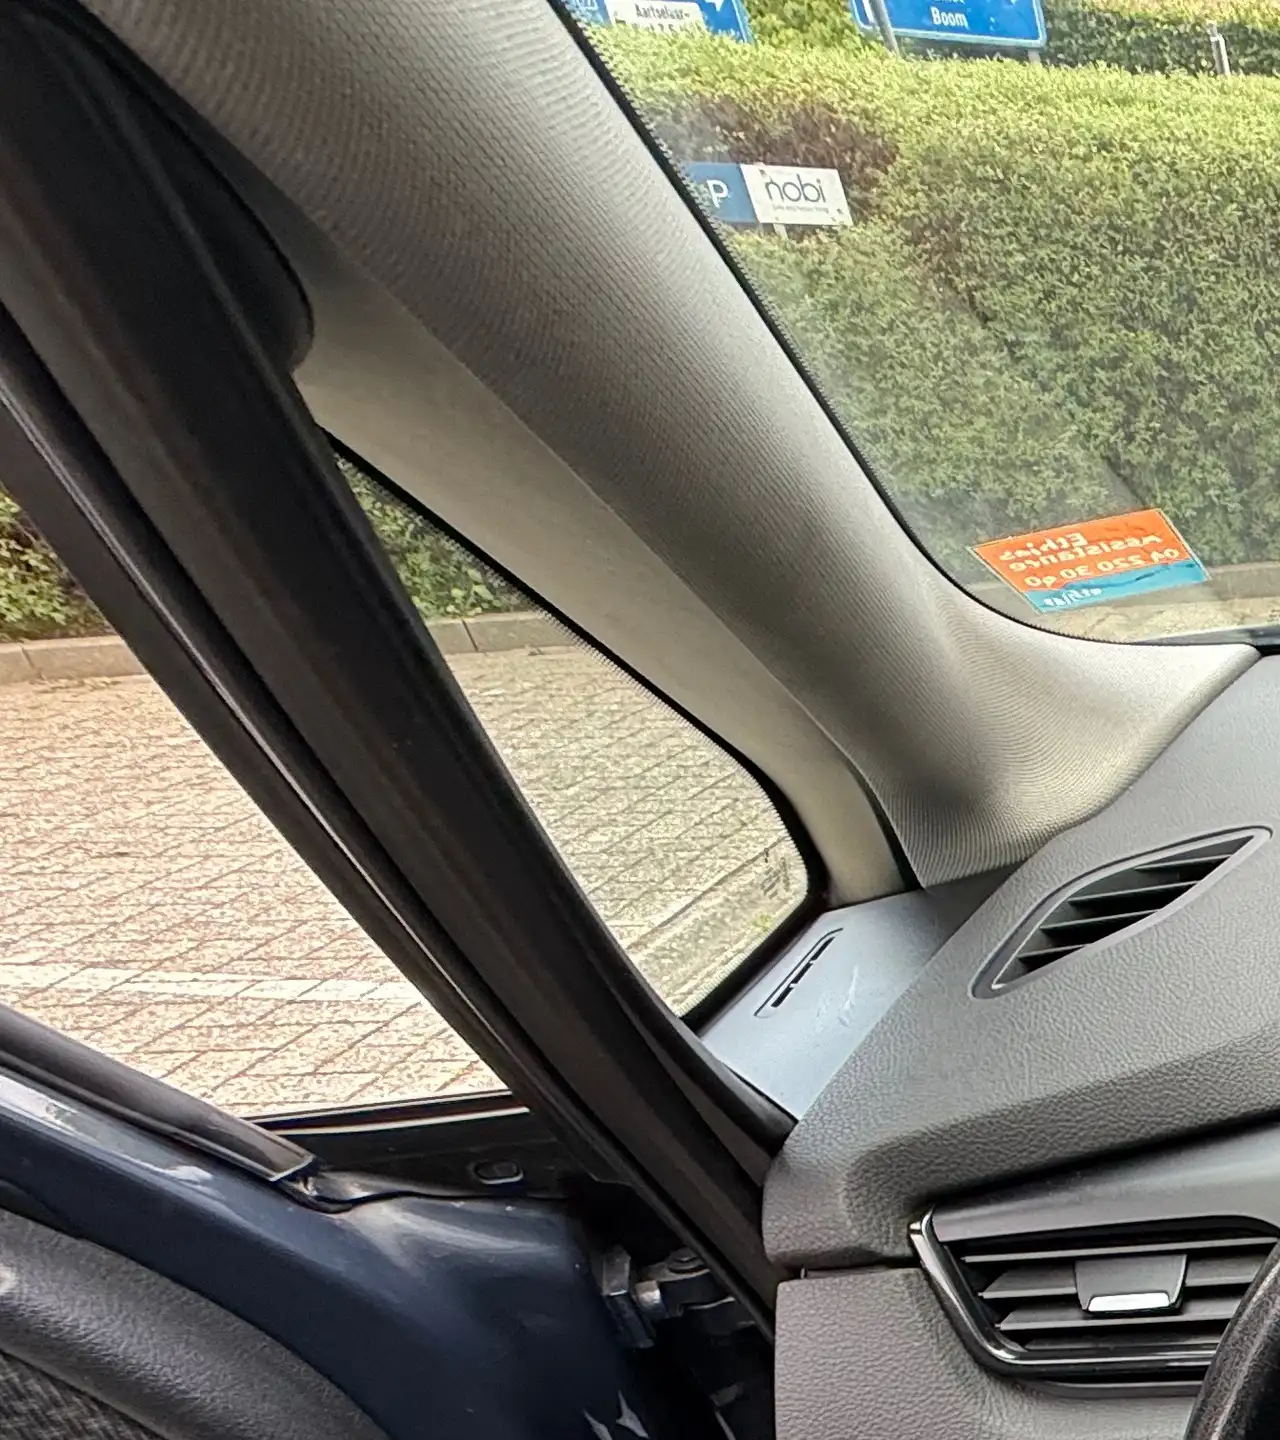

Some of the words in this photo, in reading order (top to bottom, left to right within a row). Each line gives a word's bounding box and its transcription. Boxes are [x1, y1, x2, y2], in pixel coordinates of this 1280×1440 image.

[931, 6, 968, 29] Boom
[706, 179, 729, 209] P
[764, 173, 826, 203] nobi
